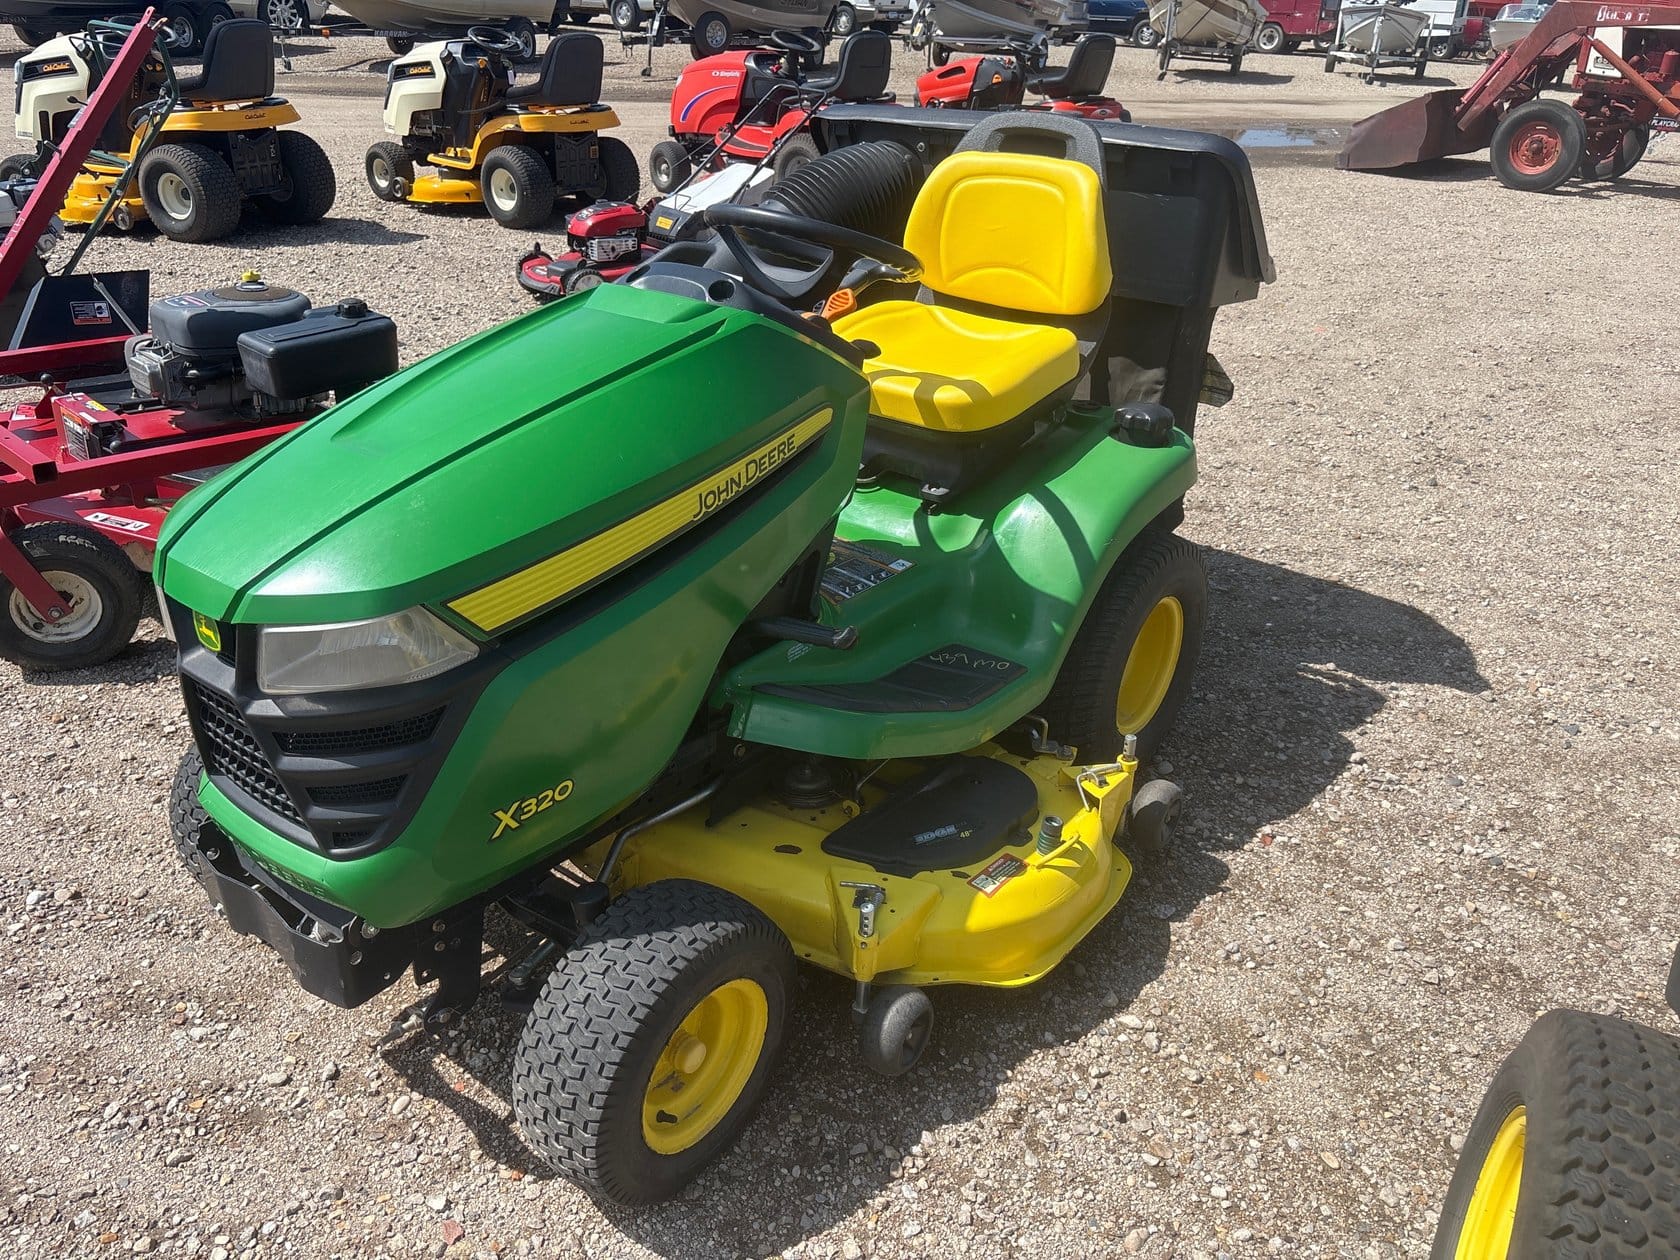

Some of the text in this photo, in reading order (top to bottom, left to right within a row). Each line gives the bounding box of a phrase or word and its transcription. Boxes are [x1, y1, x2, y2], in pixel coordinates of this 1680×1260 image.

[693, 433, 797, 520] JOHN DEERE
[491, 779, 574, 840] X320
